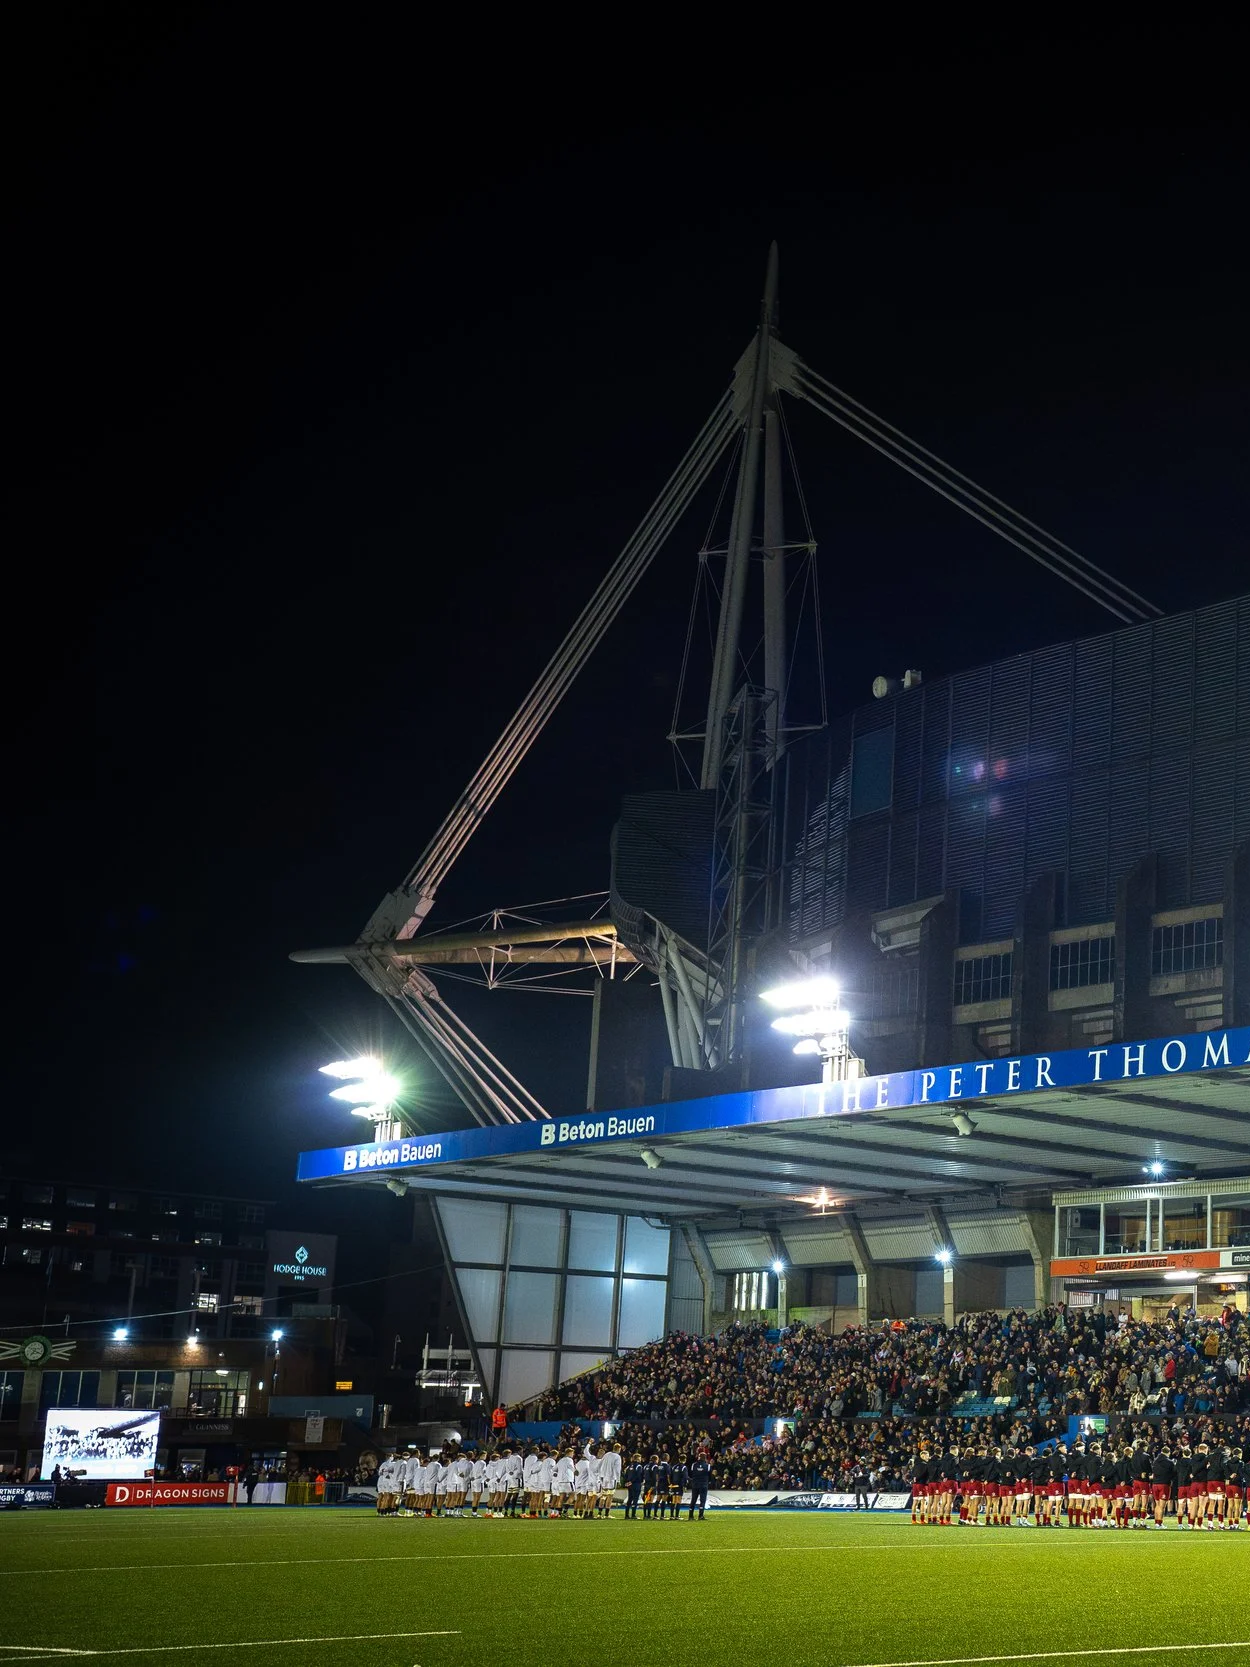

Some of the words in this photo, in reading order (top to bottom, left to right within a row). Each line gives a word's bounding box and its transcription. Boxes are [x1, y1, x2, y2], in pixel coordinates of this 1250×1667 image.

[817, 1078, 889, 1117] THE
[921, 1057, 1056, 1102] PETER
[559, 1121, 605, 1141] Beton
[607, 1115, 655, 1136] Bauen
[359, 1147, 399, 1168] Beton
[401, 1143, 442, 1162] Bauen
[273, 1264, 300, 1274] HODGE
[302, 1266, 327, 1277] HOUSE
[1095, 1261, 1128, 1271] LLANDAFF
[1129, 1258, 1167, 1270] LAMINATES
[136, 1489, 189, 1499] DRAGON
[191, 1488, 225, 1498] SIGNS
